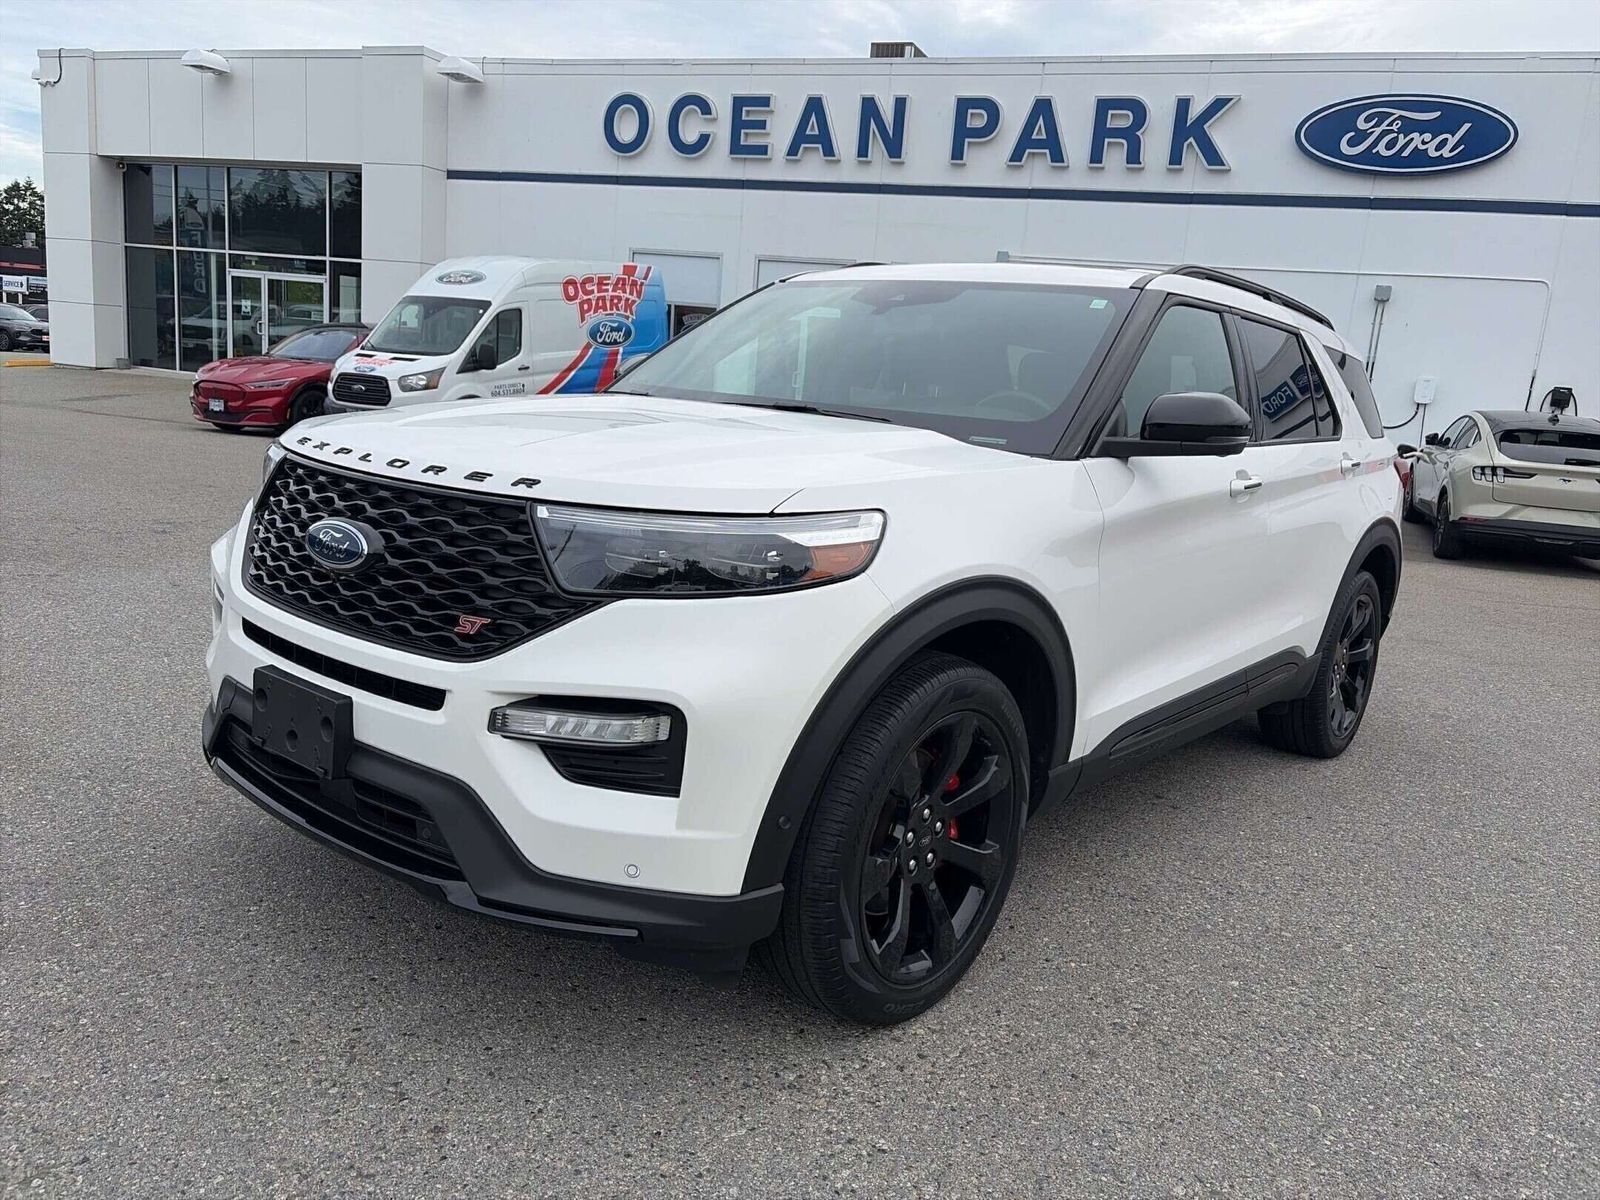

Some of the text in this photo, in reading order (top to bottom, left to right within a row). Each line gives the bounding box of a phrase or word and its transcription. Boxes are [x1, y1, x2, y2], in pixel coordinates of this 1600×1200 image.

[602, 91, 1241, 171] OCEAN PARK
[1339, 107, 1473, 158] Ford
[562, 274, 645, 303] OCEAN
[578, 294, 637, 325] PARK
[597, 321, 626, 343] Ford
[296, 436, 542, 489] EXPLORER
[315, 528, 351, 558] Ford
[454, 614, 491, 635] ST
